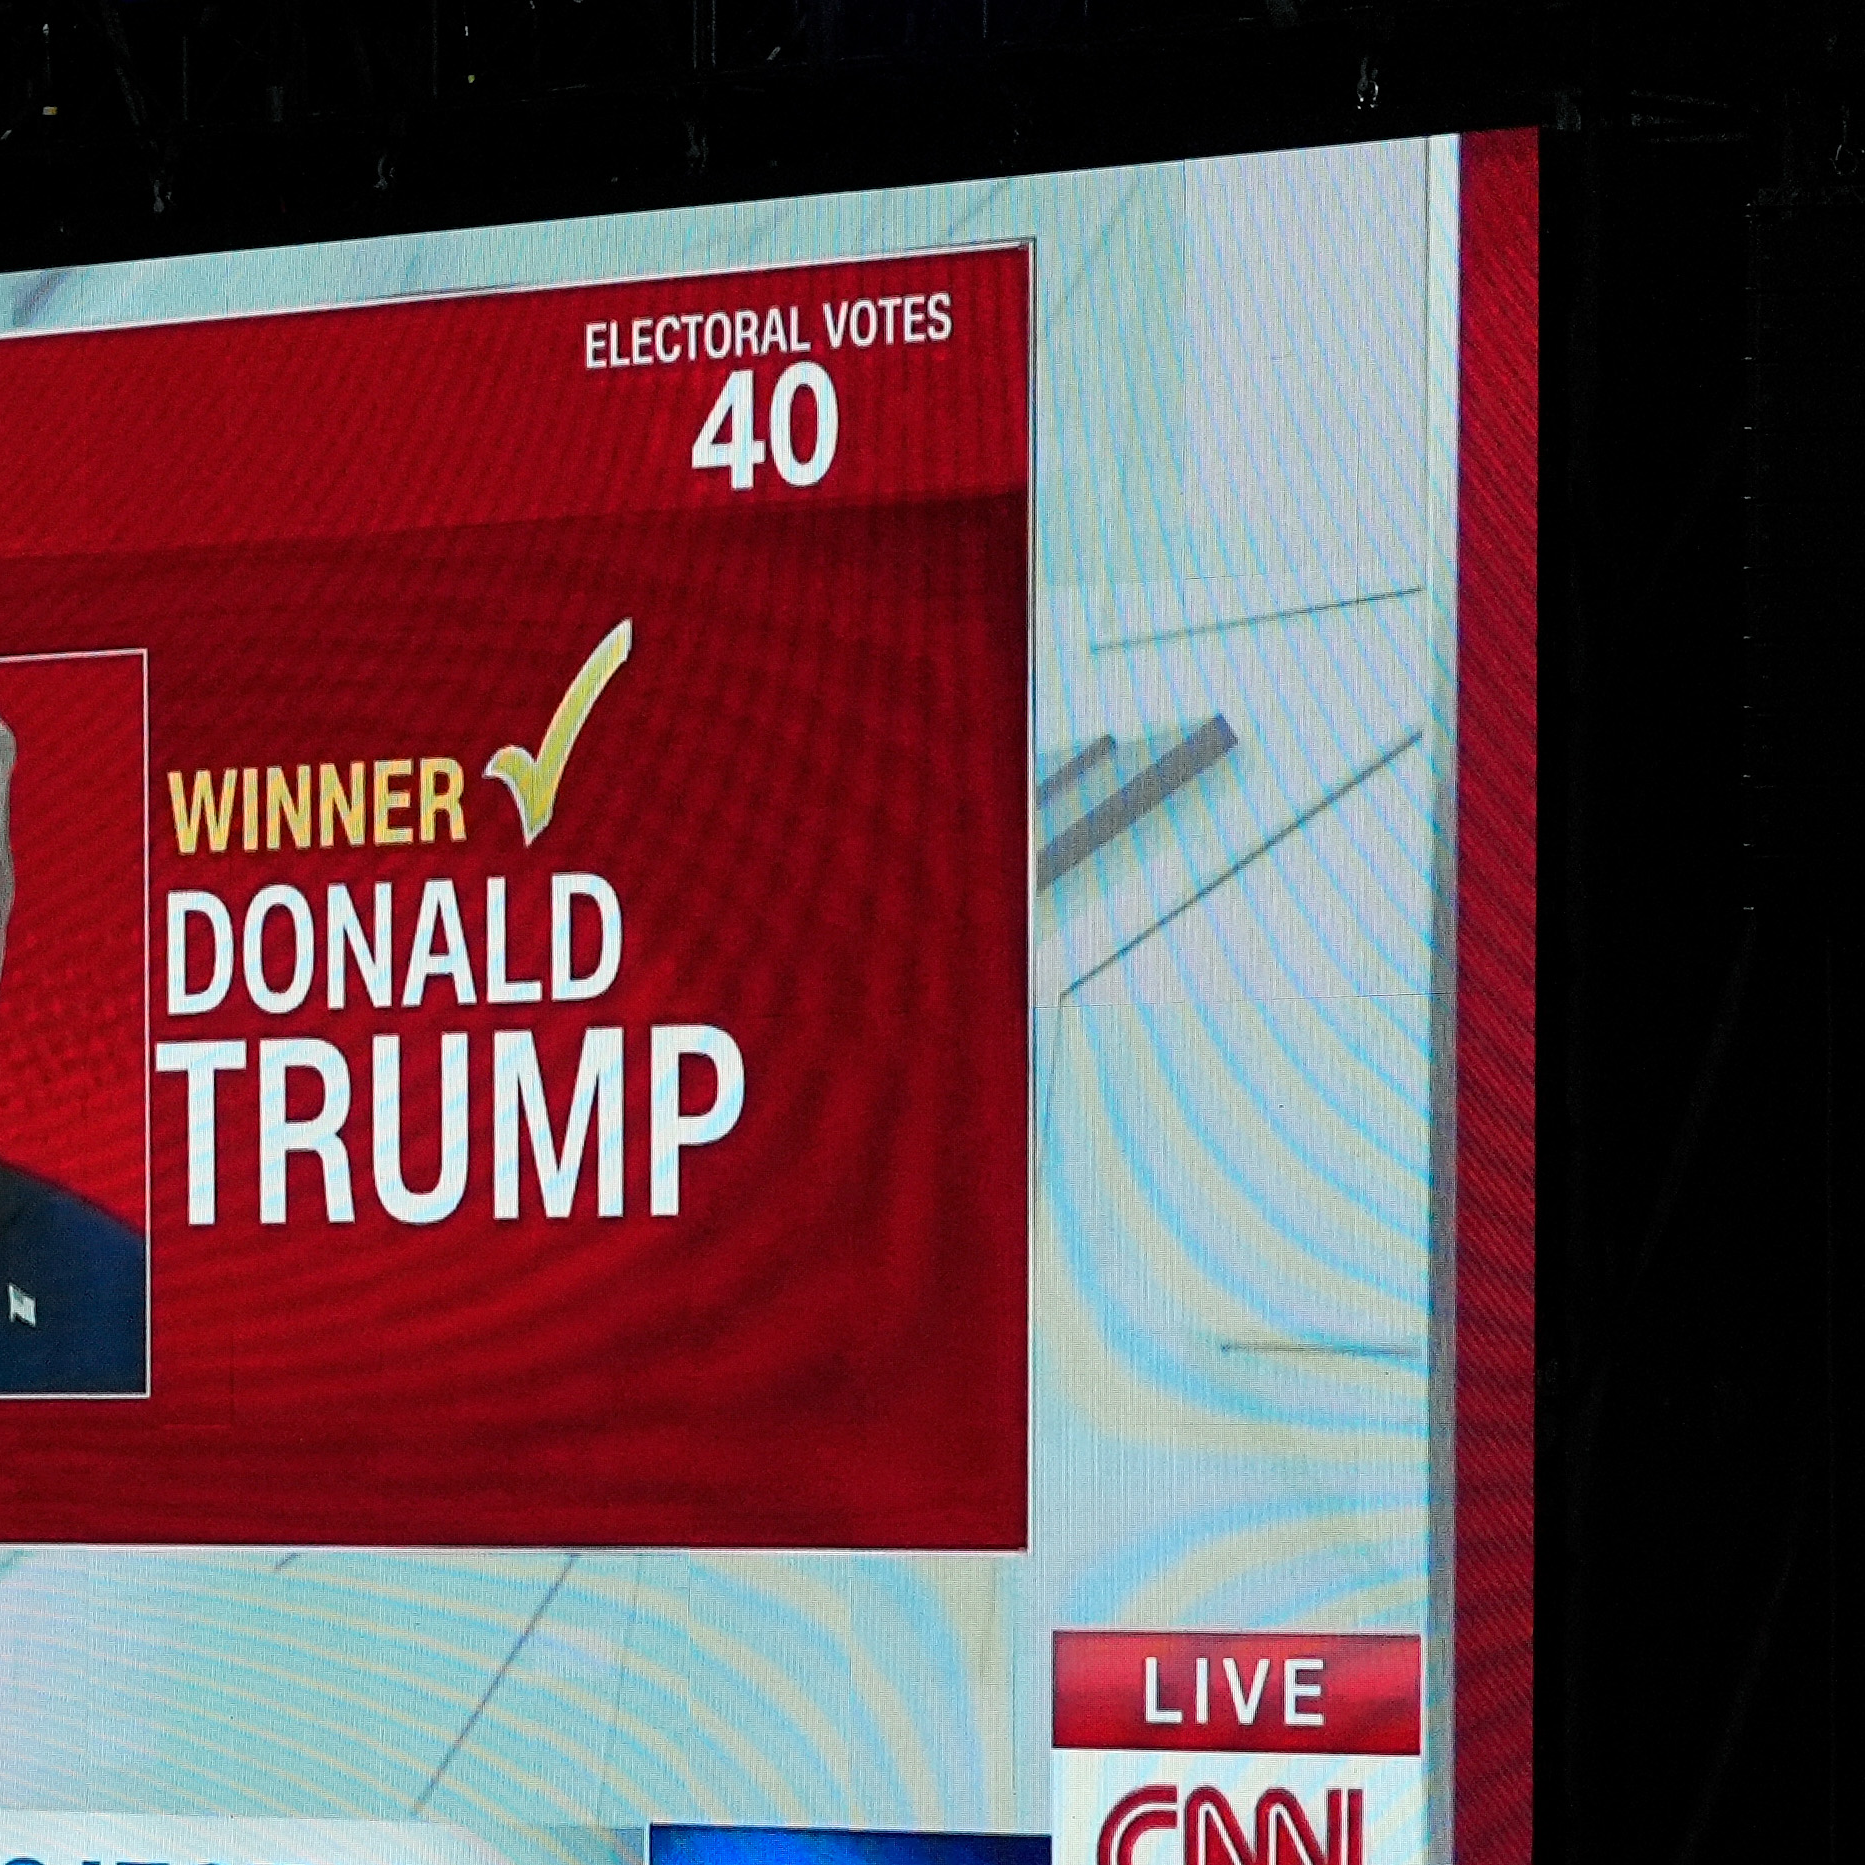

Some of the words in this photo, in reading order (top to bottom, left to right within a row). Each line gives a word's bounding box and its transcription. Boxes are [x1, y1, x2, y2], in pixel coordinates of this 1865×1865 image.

[585, 304, 811, 369] ELECTORAL
[822, 292, 953, 349] VOTES
[691, 360, 839, 491] 40
[167, 756, 468, 855] WINNER
[167, 871, 622, 1016] DONALD
[155, 1023, 746, 1226] TRUMP
[1144, 1656, 1325, 1726] LIVE
